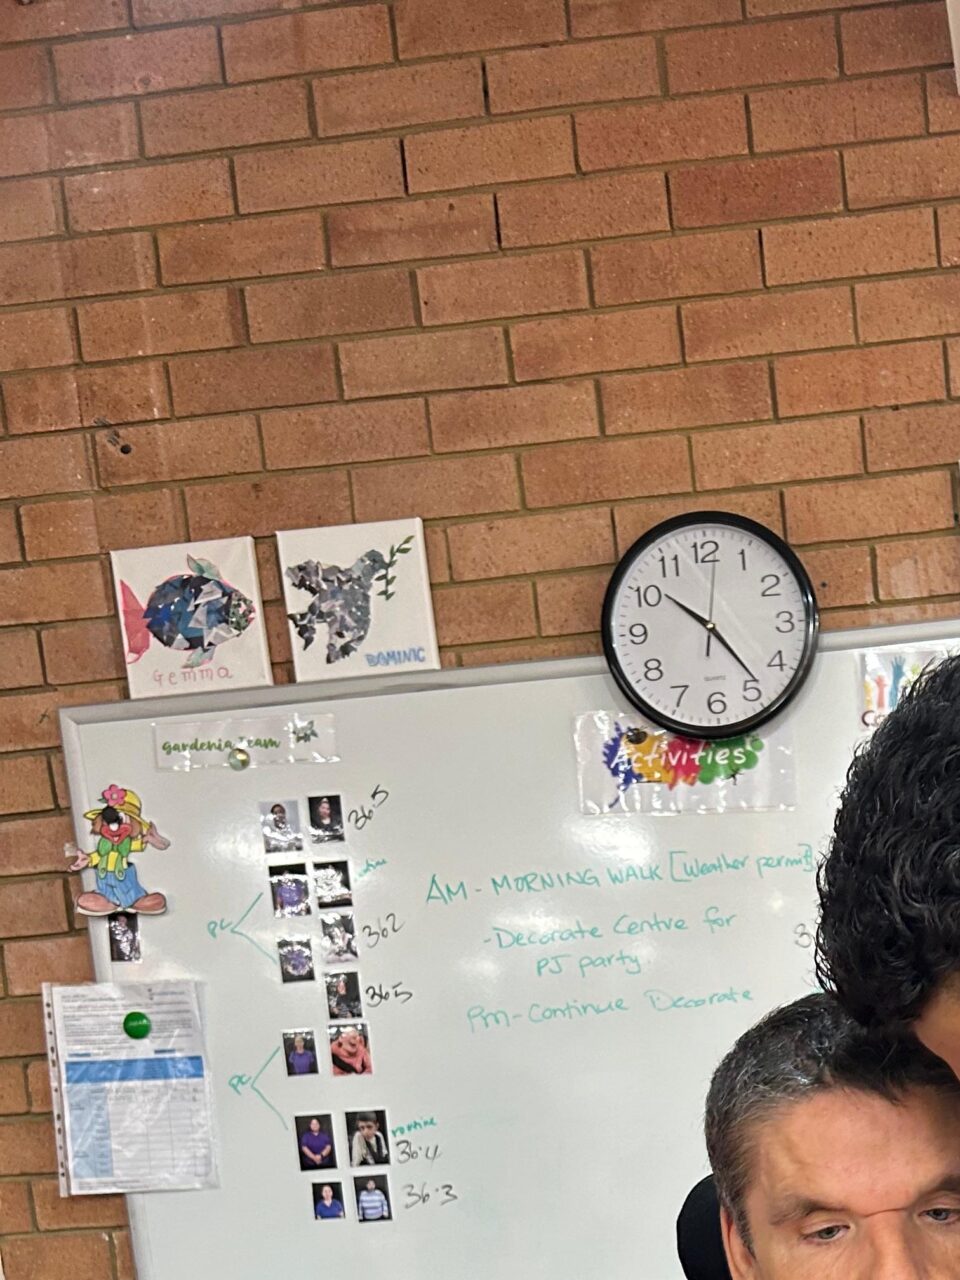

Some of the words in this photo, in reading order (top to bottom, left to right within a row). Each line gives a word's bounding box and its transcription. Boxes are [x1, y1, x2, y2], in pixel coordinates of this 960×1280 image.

[690, 540, 720, 564] 12
[738, 549, 747, 571] 1
[658, 554, 680, 578] 11
[634, 584, 663, 608] 10
[760, 574, 781, 597] 2
[775, 611, 795, 633] 3
[629, 623, 648, 645] 9
[365, 646, 426, 667] DOMINIC
[766, 650, 787, 672] 4
[643, 658, 664, 681] 8
[669, 684, 690, 708] 7
[742, 679, 763, 702] 5
[706, 691, 727, 714] 6
[610, 745, 747, 769] Activities
[490, 870, 600, 897] MORNING
[607, 864, 665, 886] WALK
[613, 912, 690, 936] Centre
[703, 906, 737, 934] for
[536, 953, 565, 976] PJ
[579, 951, 642, 978] party
[645, 987, 755, 1013] Decorate
